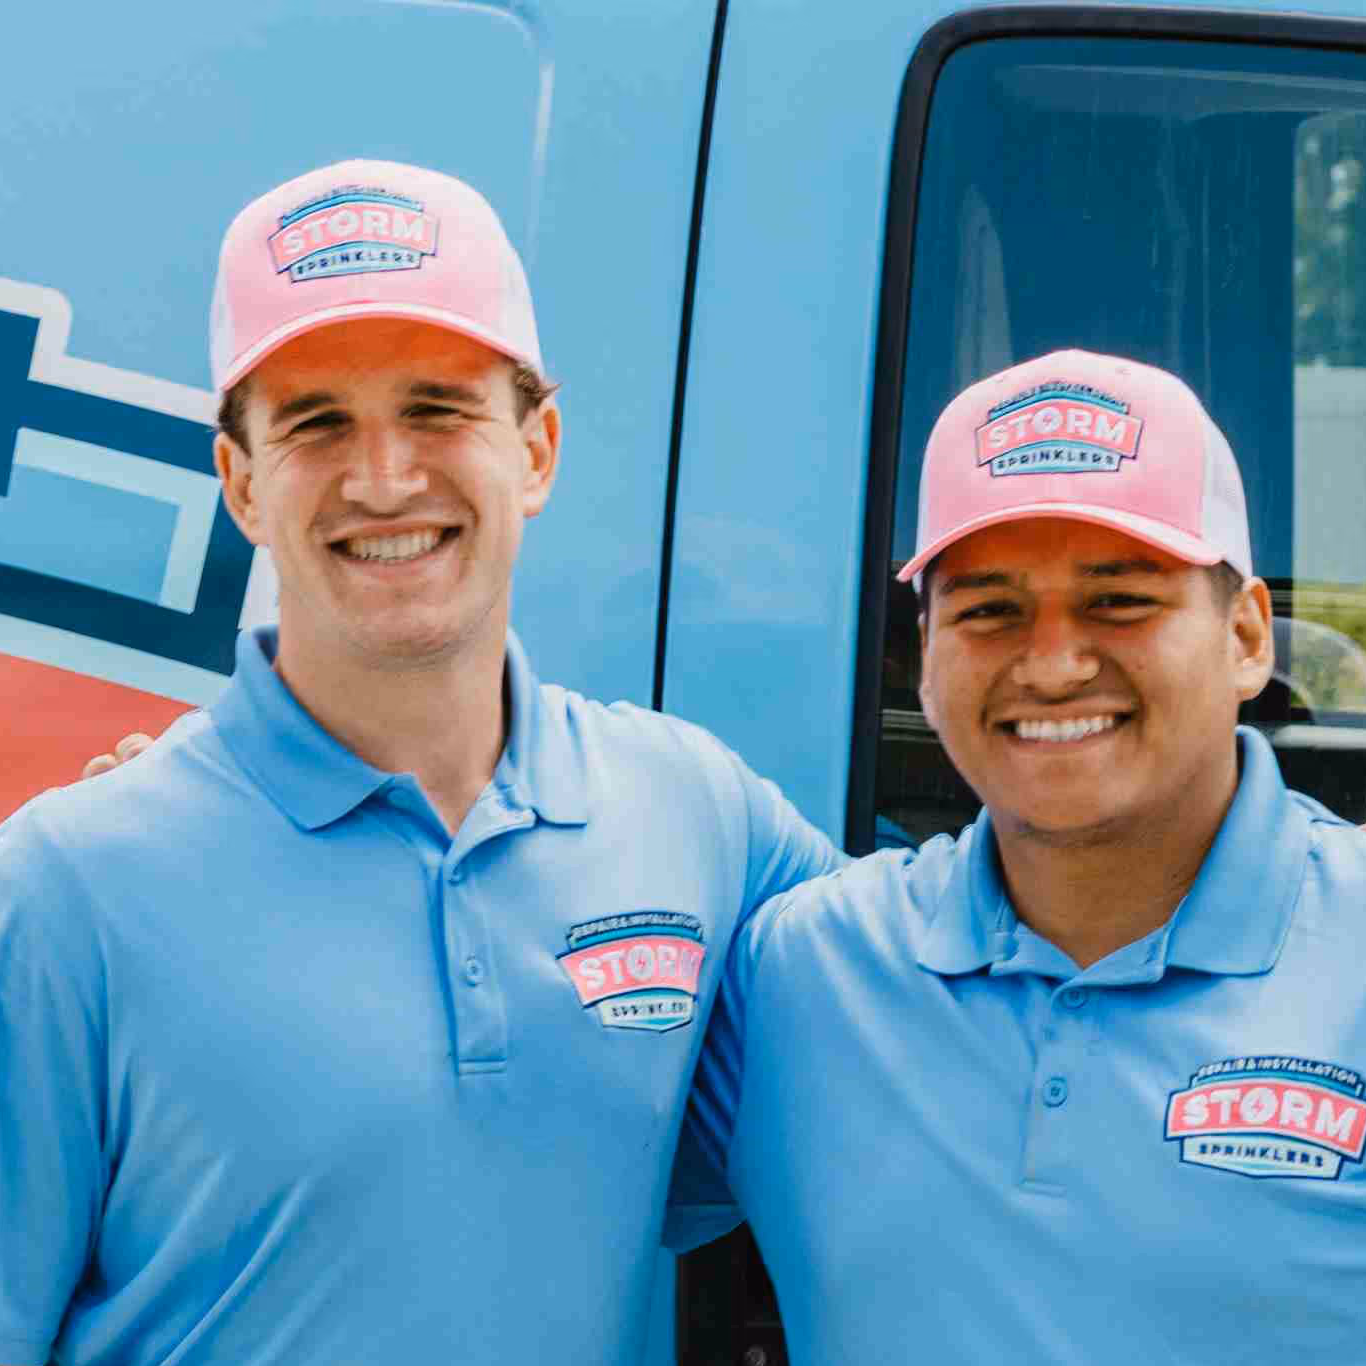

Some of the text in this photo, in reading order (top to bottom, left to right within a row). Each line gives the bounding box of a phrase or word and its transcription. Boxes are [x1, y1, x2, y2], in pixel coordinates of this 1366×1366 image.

[283, 208, 425, 256] STORM
[988, 406, 1126, 448] STORM
[1182, 1086, 1358, 1142] STORM
